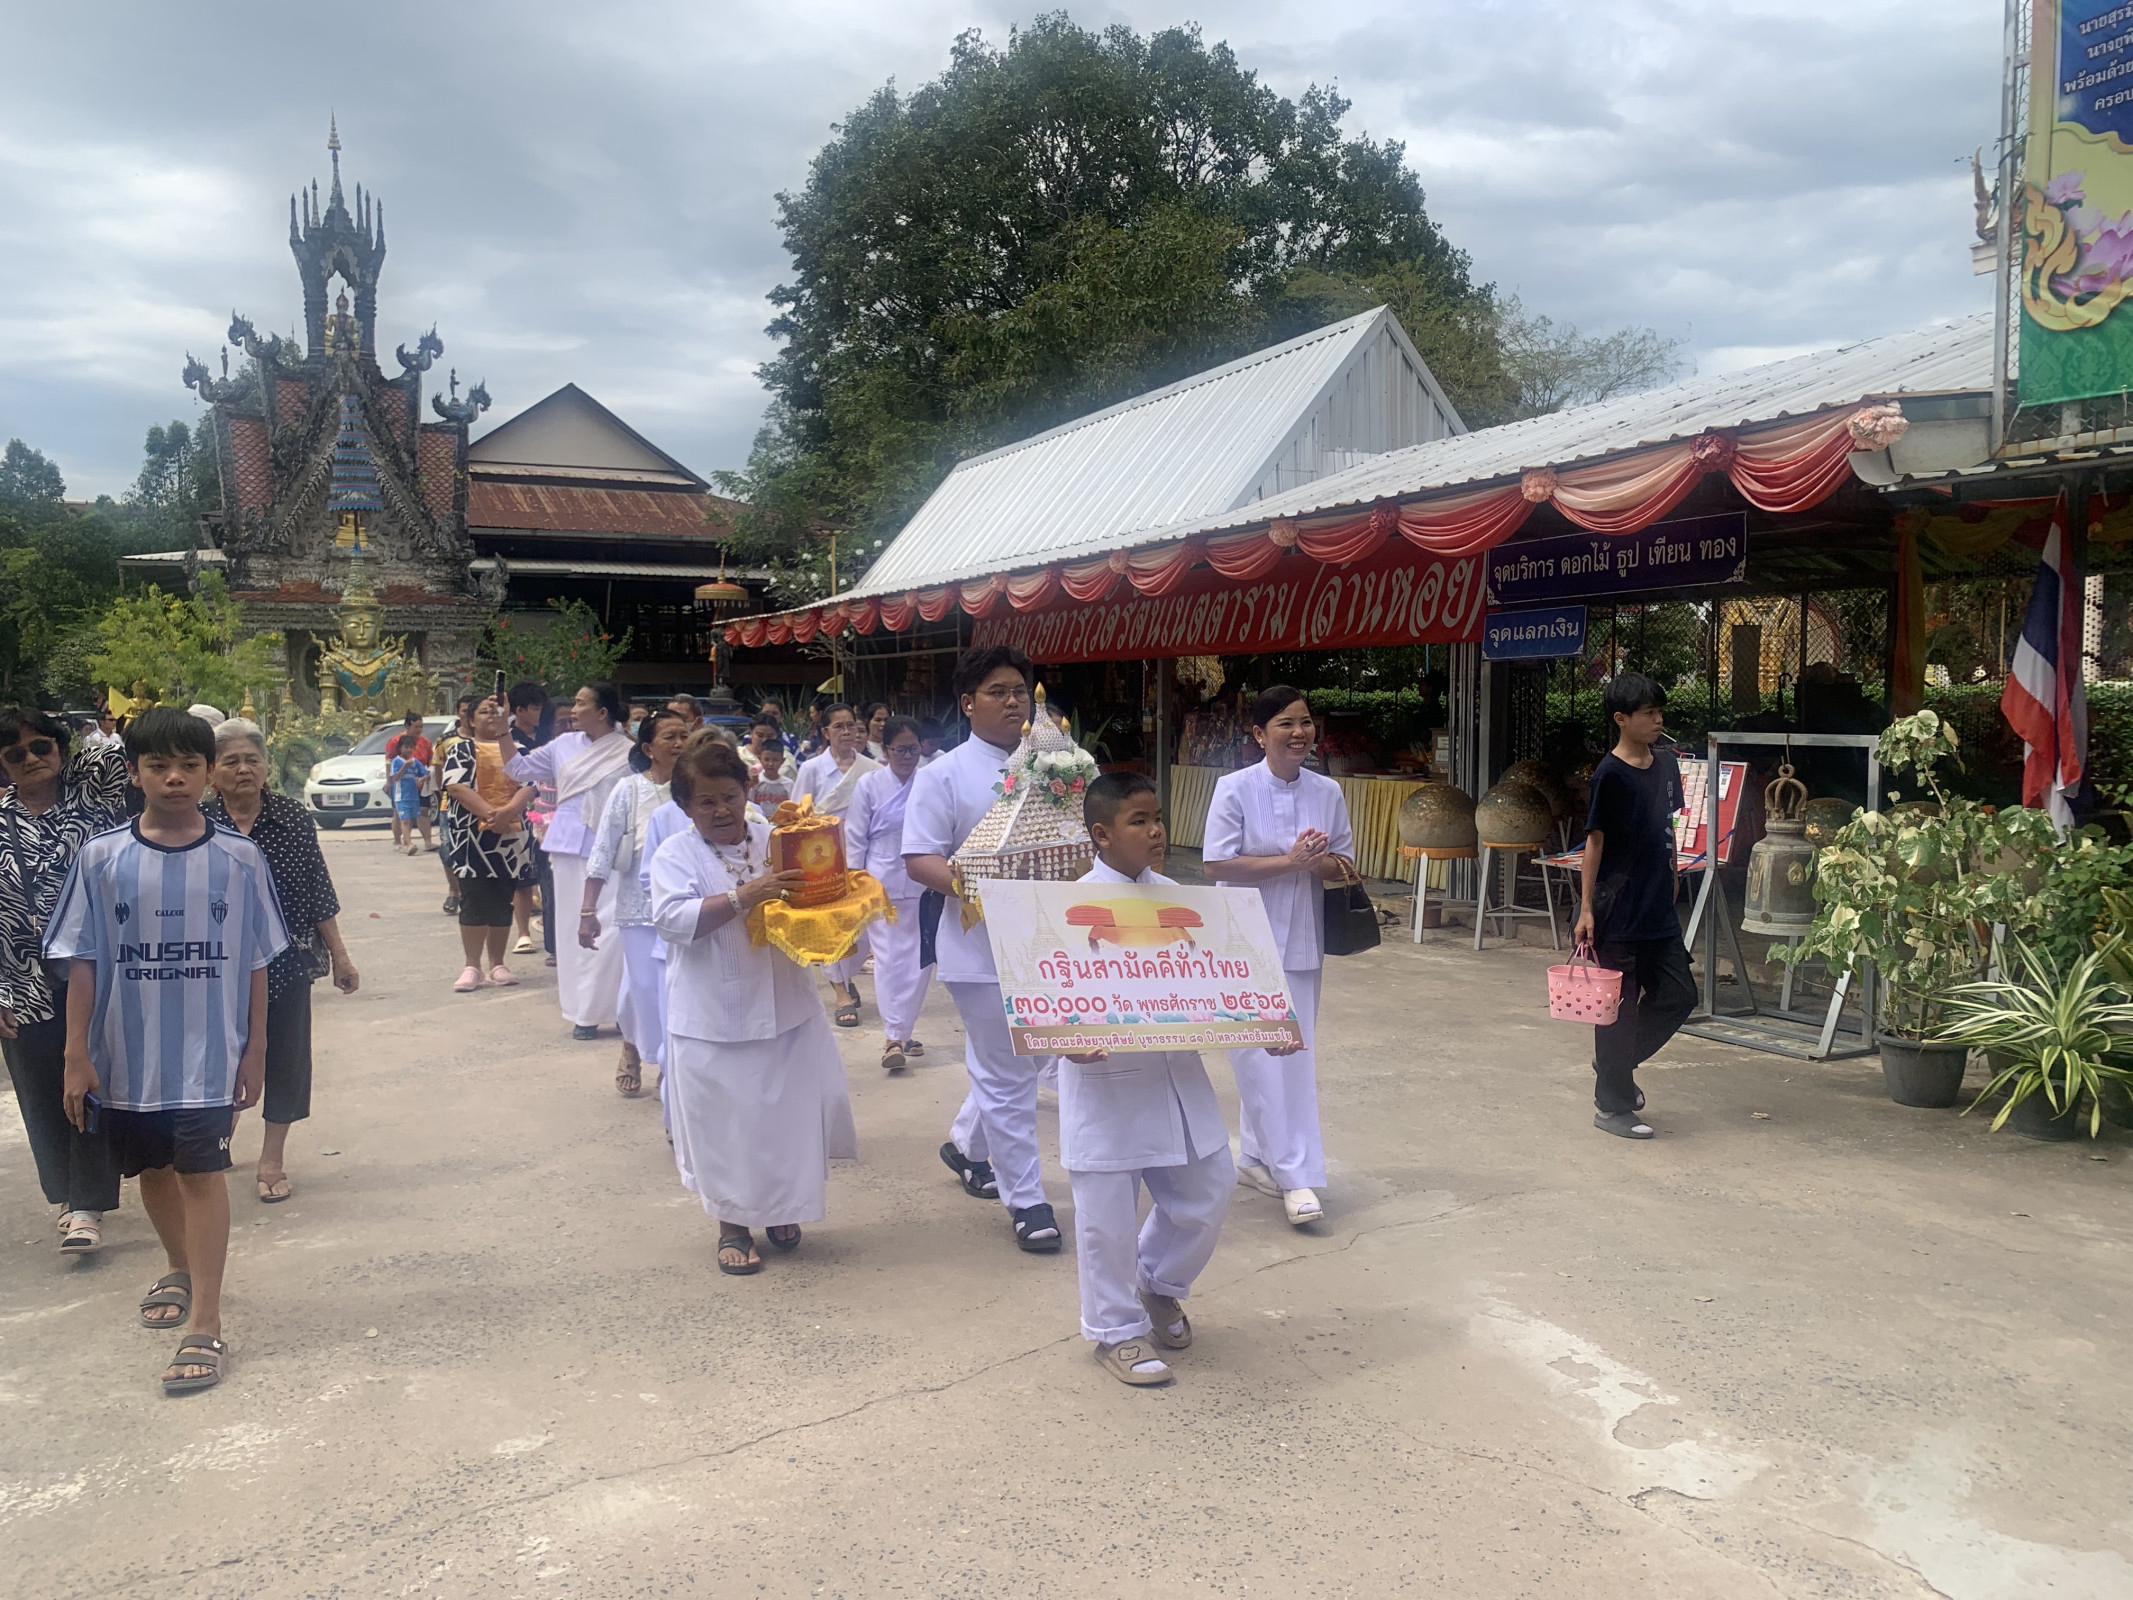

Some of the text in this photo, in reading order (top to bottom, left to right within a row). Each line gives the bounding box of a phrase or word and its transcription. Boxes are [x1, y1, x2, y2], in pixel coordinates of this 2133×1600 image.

[2064, 59, 2133, 93] พร้อมด้วย
[1493, 536, 1737, 590] จุดบริการ ดอกไม้ ธูป เทียน ทอง
[1488, 617, 1580, 648] จุดแลกเงิน
[125, 966, 221, 981] ORIGNIAL
[1038, 943, 1250, 988] กฐินสามัคคีทั่วไทย
[1014, 991, 1287, 1018] ๓๐,๐๐๐ วัด พุทธศักราช ๒๕๖๘
[1025, 1034, 1048, 1049] โดย
[1051, 1032, 1135, 1049] คณะศิษยานุศิษย์
[1138, 1034, 1186, 1049] บูชาธรรม
[1189, 1034, 1204, 1044] ๘๑
[1206, 1030, 1214, 1043] ปี
